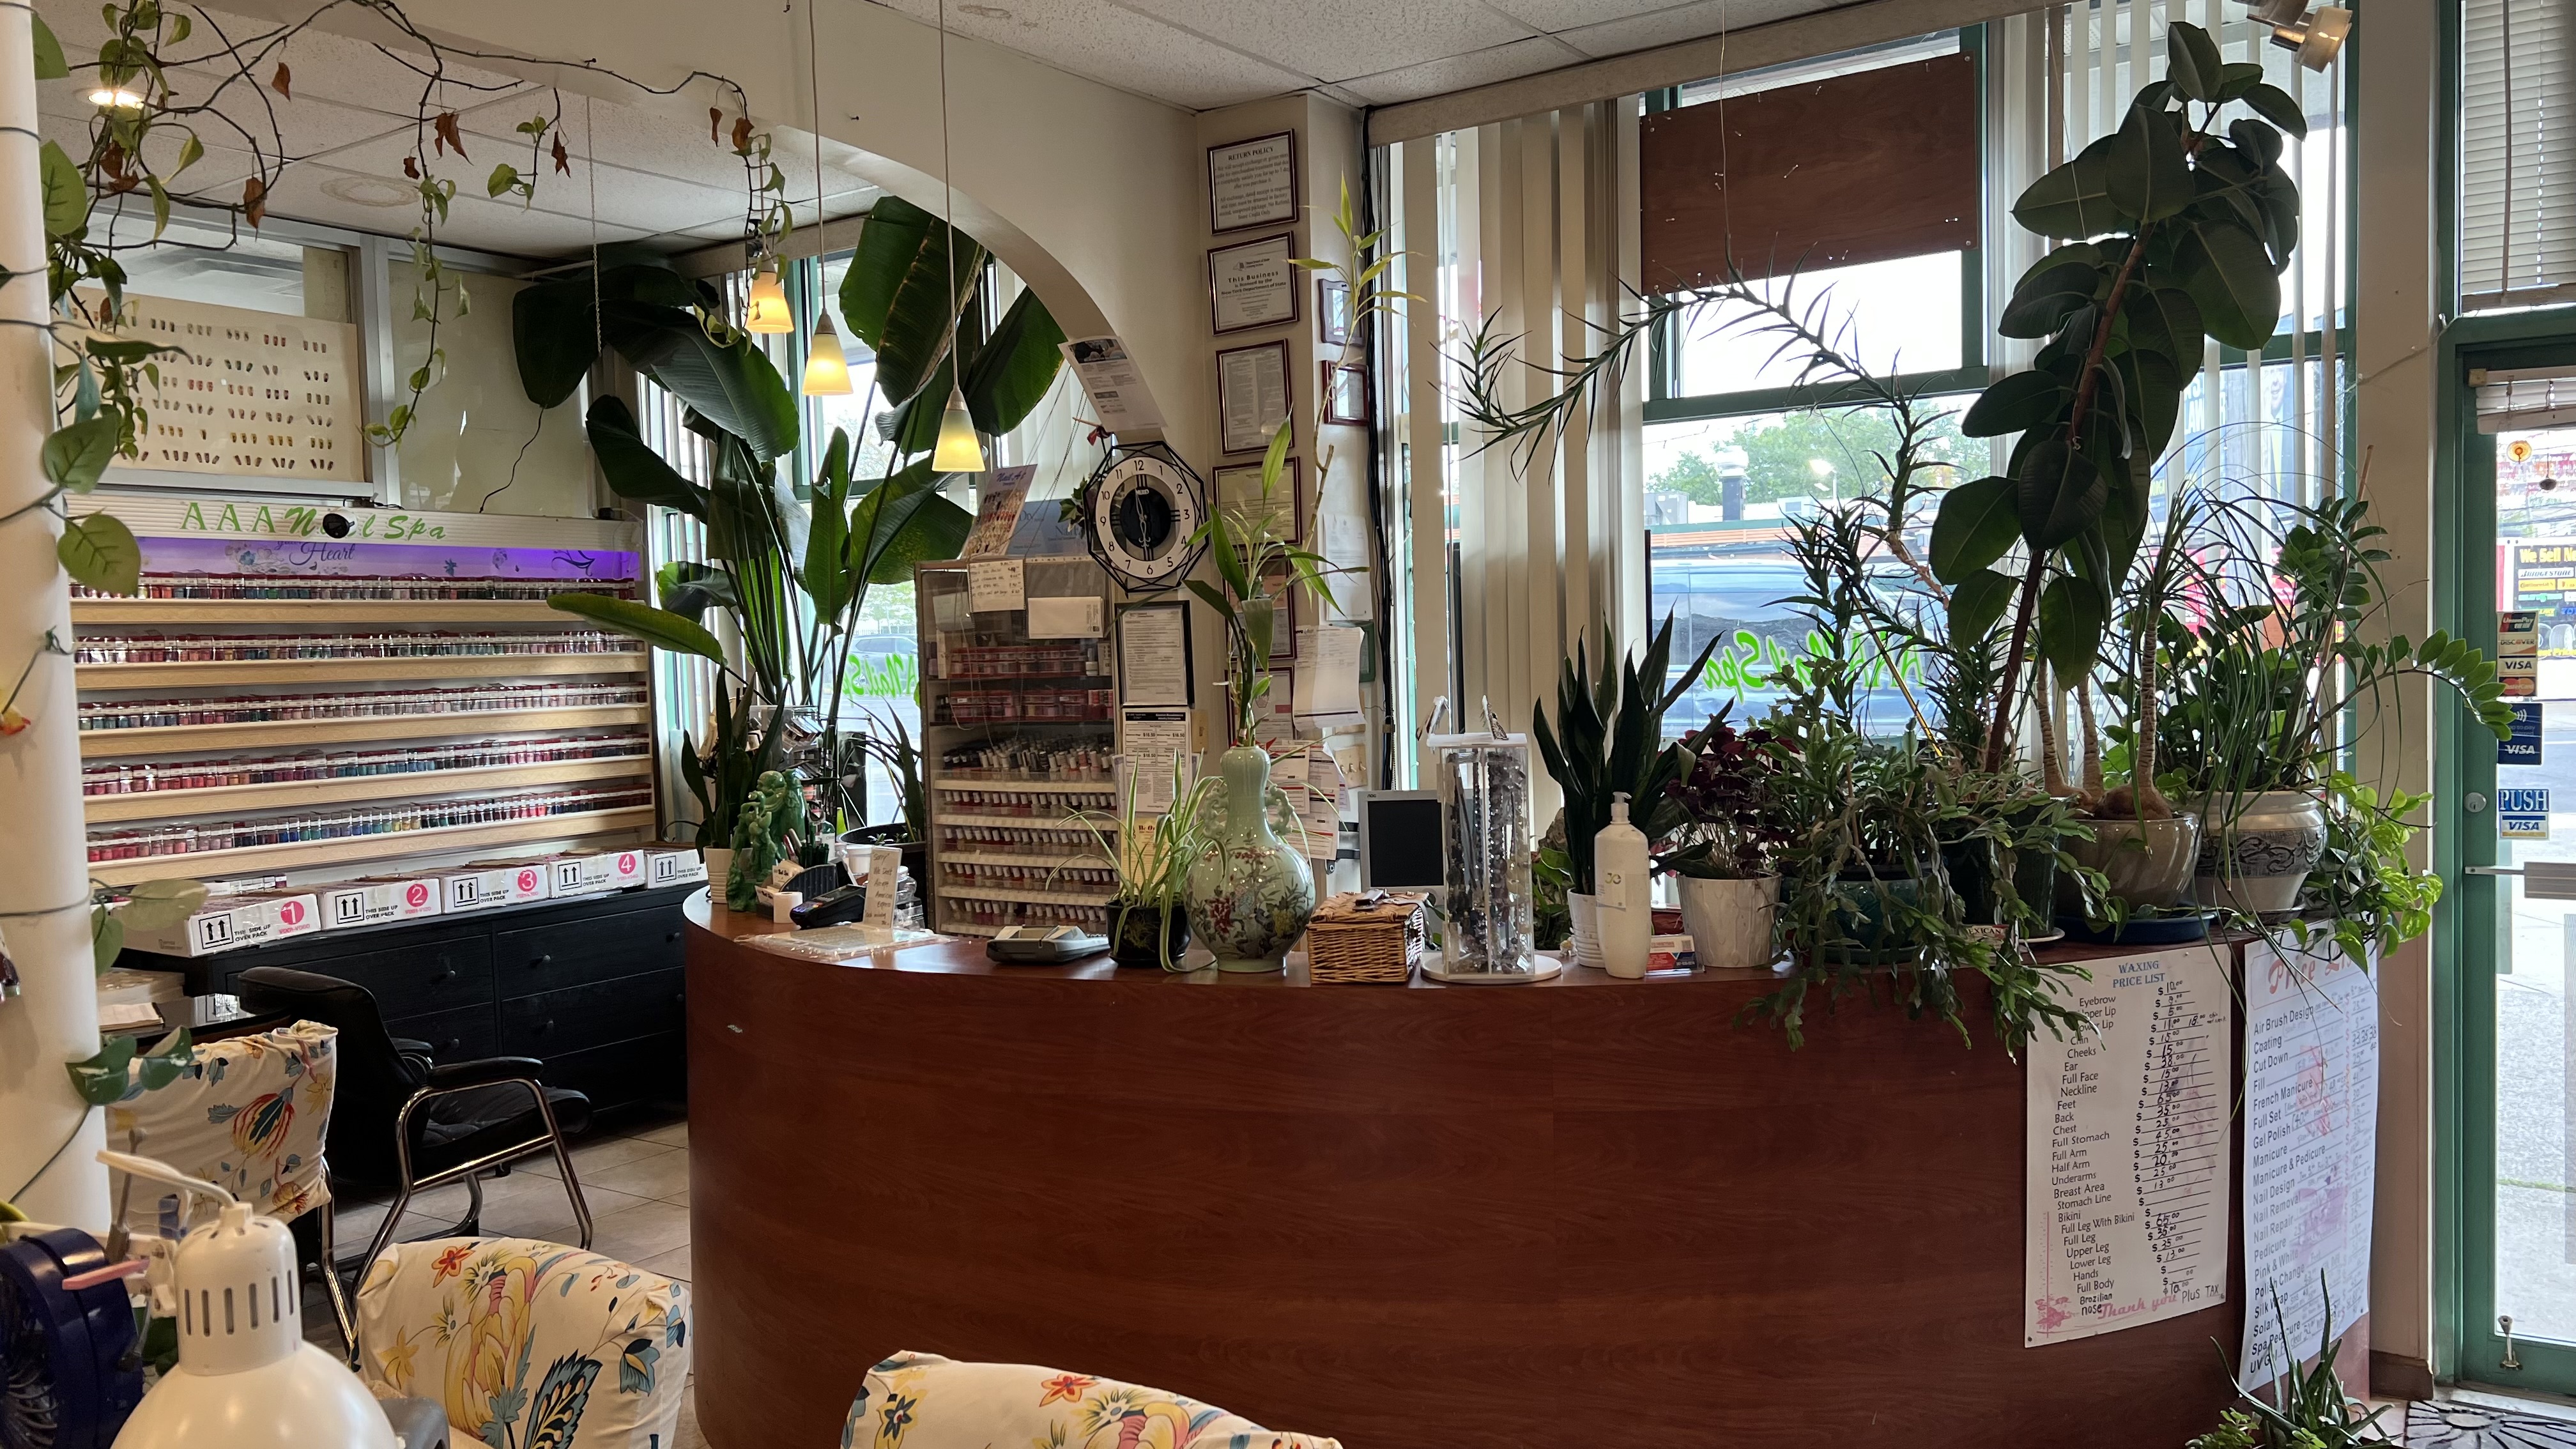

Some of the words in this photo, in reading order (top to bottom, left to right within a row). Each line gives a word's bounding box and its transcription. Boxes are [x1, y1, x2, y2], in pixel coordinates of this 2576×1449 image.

[1252, 146, 1274, 156] POLICY
[1246, 271, 1278, 280] Business
[1134, 459, 1144, 471] 12
[1159, 465, 1163, 475] 1
[1115, 469, 1123, 480] 11
[1101, 490, 1110, 501] 10
[1176, 483, 1183, 494] 2
[1100, 516, 1107, 526] 9
[1184, 509, 1190, 520] 3
[284, 507, 376, 538] Nl
[383, 515, 446, 541] Spa
[1108, 541, 1115, 551] 8
[1181, 535, 1187, 545] 4
[289, 542, 355, 565] Heart
[2520, 548, 2537, 564] We
[2539, 547, 2561, 563] Sell
[1125, 560, 1131, 570] 7
[1167, 556, 1173, 567] 5
[1147, 564, 1153, 575] 6
[2503, 616, 2534, 625] UnionPay
[2505, 661, 2533, 670] VISA
[2504, 745, 2536, 755] VISA
[2499, 789, 2549, 811] PUSH
[2508, 821, 2540, 831] VISA
[621, 855, 632, 871] 4
[521, 871, 534, 889] 3
[411, 886, 424, 904] 2
[287, 902, 298, 924] 1
[2119, 960, 2159, 974] WAXING
[2113, 976, 2142, 988] PRICE
[2145, 972, 2166, 984] LIST
[2269, 955, 2315, 995] Price
[2079, 995, 2117, 1008] Eyebrow
[2078, 1009, 2103, 1020] pper
[2104, 1006, 2117, 1018] Lip
[2102, 1020, 2114, 1031] Lip
[2253, 1022, 2264, 1036] Air
[2266, 1015, 2288, 1033] Brush
[2289, 1005, 2314, 1023] Design
[2070, 1036, 2089, 1046] Cin
[2253, 1035, 2283, 1055] Coating
[2067, 1046, 2097, 1059] Cheeks
[2064, 1062, 2079, 1071] Ear
[2253, 1059, 2267, 1074] Cut
[2267, 1052, 2289, 1069] Down
[2062, 1073, 2077, 1084] Full
[2080, 1072, 2099, 1081] Face
[2253, 1077, 2266, 1093] Fill
[2060, 1084, 2097, 1098] Neckline
[2253, 1091, 2280, 1112] French
[2280, 1078, 2313, 1100] Manicure
[2057, 1100, 2076, 1110] Feet
[2055, 1112, 2074, 1123] Back
[2253, 1115, 2267, 1131] Full
[2269, 1108, 2281, 1124] Set
[2053, 1124, 2077, 1135] Chest
[2253, 1134, 2266, 1149] Gel
[2267, 1124, 2291, 1144] Polish
[2052, 1137, 2068, 1148] Full
[2071, 1131, 2110, 1144] Stomach
[2052, 1150, 2067, 1162] Full
[2069, 1149, 2087, 1158] Arm
[2253, 1145, 2288, 1169] Manicure
[2051, 1162, 2071, 1174] Half
[2073, 1160, 2090, 1170] Arm
[2253, 1164, 2288, 1188] Manicure
[2289, 1157, 2294, 1170] &
[2296, 1145, 2326, 1165] Pedicure
[2051, 1171, 2097, 1186] Underarms
[2054, 1186, 2081, 1199] Breast
[2084, 1183, 2105, 1193] Area
[2253, 1190, 2268, 1207] Nail
[2269, 1178, 2295, 1199] Design
[2057, 1198, 2092, 1210] Stomach
[2095, 1193, 2112, 1204] Line
[2253, 1209, 2268, 1225] Nail
[2269, 1193, 2300, 1215] Removal
[2058, 1211, 2081, 1223] Bikini
[2061, 1223, 2075, 1234] Full
[2078, 1221, 2091, 1232] Leg
[2093, 1218, 2112, 1229] With
[2114, 1213, 2135, 1225] Bikini
[2253, 1227, 2268, 1244] Nail
[2269, 1215, 2293, 1236] Repair
[2064, 1235, 2079, 1246] Full
[2082, 1233, 2096, 1243] Leg
[2066, 1248, 2093, 1260] Upper
[2096, 1243, 2110, 1254] Leg
[2254, 1238, 2287, 1263] Pedicure
[2070, 1259, 2095, 1269] Lower
[2097, 1255, 2112, 1266] Leg
[2255, 1266, 2271, 1282] Pink
[2272, 1261, 2278, 1276] &
[2278, 1248, 2299, 1268] White
[2073, 1269, 2099, 1282] Hands
[2255, 1279, 2278, 1301] Polish
[2278, 1263, 2306, 1287] Change
[2076, 1282, 2091, 1294] Full
[2094, 1278, 2115, 1291] Body
[2204, 1284, 2220, 1298] TAX
[2081, 1303, 2102, 1316] nose
[2097, 1297, 2146, 1320] Thank
[2151, 1294, 2177, 1312] you
[2255, 1302, 2269, 1319] Silk
[2253, 1317, 2274, 1338] Solar
[2276, 1306, 2289, 1326] Nil
[2251, 1340, 2267, 1356] Spa
[2269, 1321, 2301, 1344] Pedure
[2250, 1356, 2263, 1374] UV
[2264, 1349, 2278, 1367] Gl
